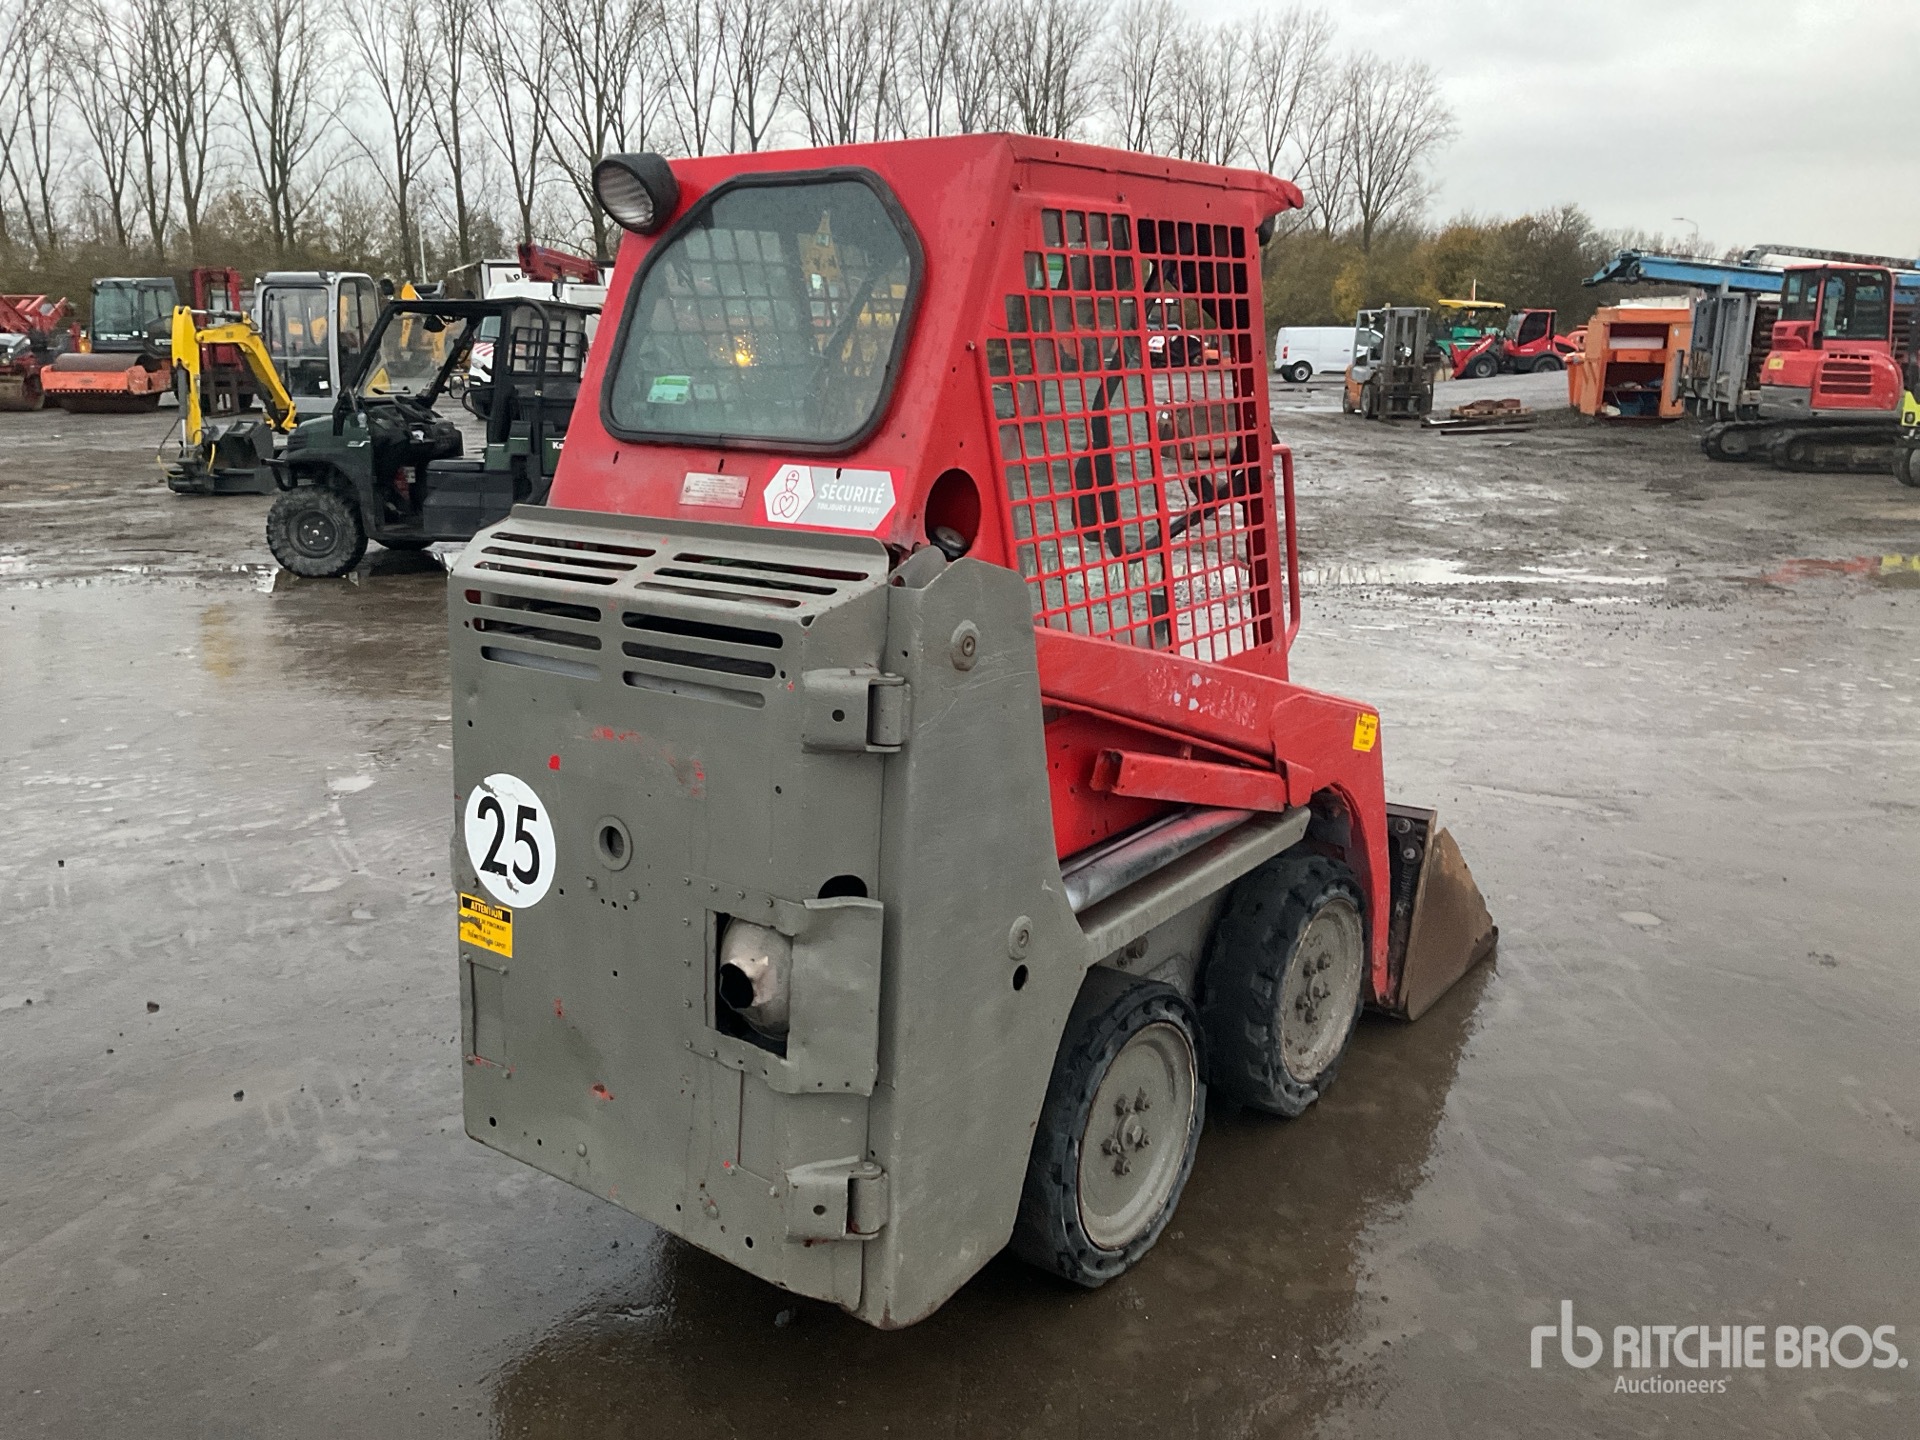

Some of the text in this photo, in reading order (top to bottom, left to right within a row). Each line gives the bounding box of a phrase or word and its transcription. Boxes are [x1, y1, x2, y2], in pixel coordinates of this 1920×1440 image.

[819, 480, 885, 504] SÉCURITÉ
[478, 795, 540, 885] 25
[471, 901, 503, 920] ATTENTION
